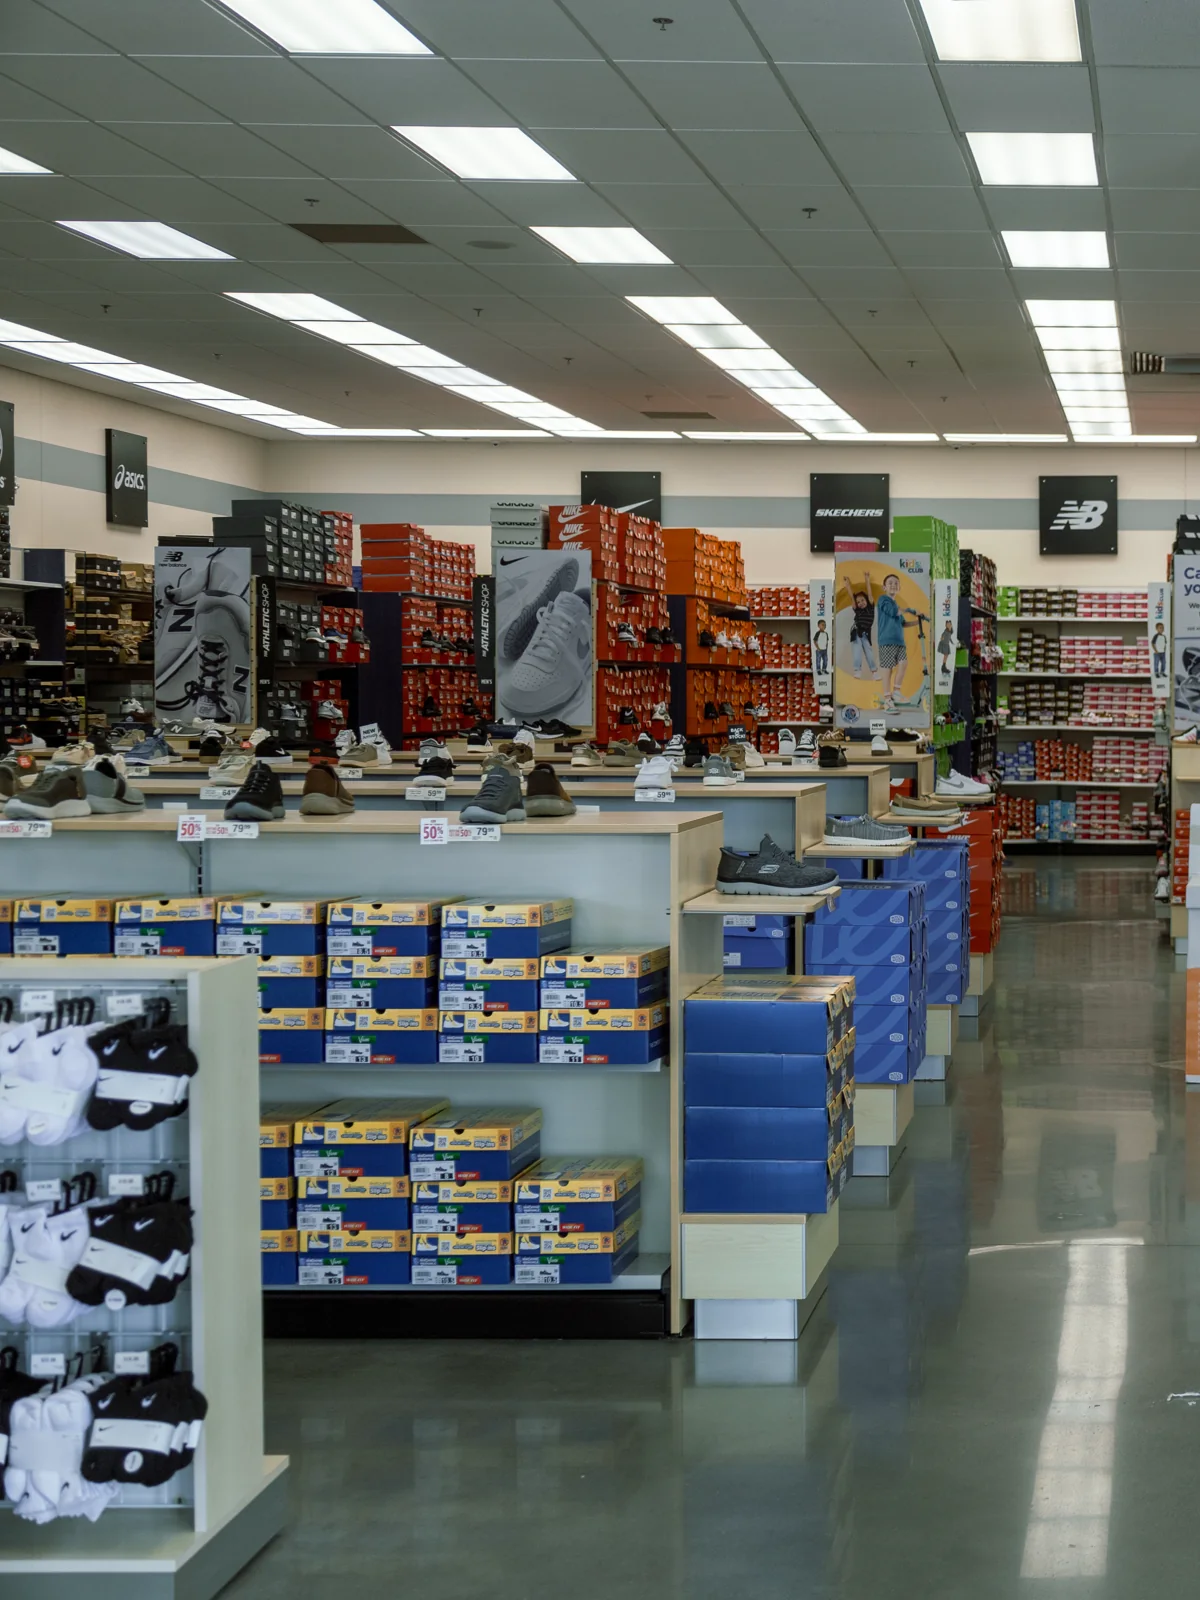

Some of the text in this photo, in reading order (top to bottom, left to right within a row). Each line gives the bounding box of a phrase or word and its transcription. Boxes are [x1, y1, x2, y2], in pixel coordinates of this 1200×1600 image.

[563, 506, 582, 515] NIKE
[815, 508, 884, 518] SKECHERS
[564, 524, 584, 533] NIKE
[900, 558, 920, 568] kids
